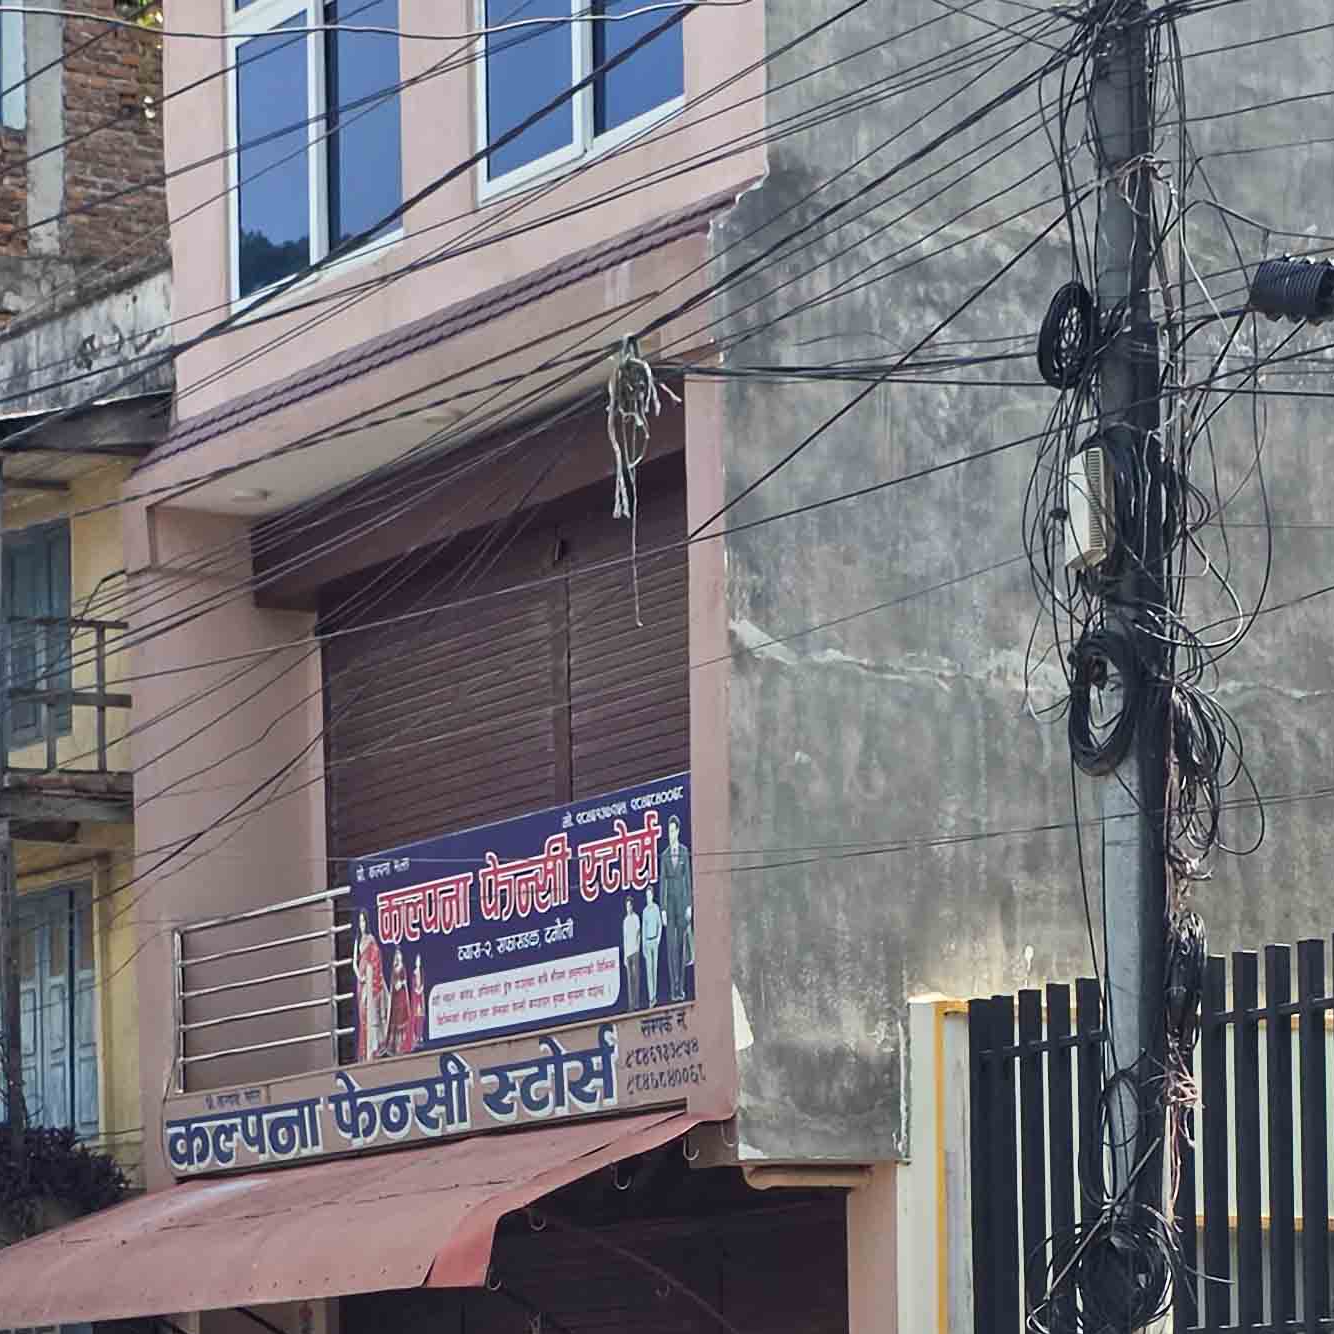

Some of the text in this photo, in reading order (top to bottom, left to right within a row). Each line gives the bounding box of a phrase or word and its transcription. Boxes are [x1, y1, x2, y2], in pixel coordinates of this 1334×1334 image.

[376, 811, 662, 944] कल्पना फेन्सी स्टोर्स
[165, 1098, 323, 1170] कल्पना
[479, 1025, 620, 1121] स्टोर्स
